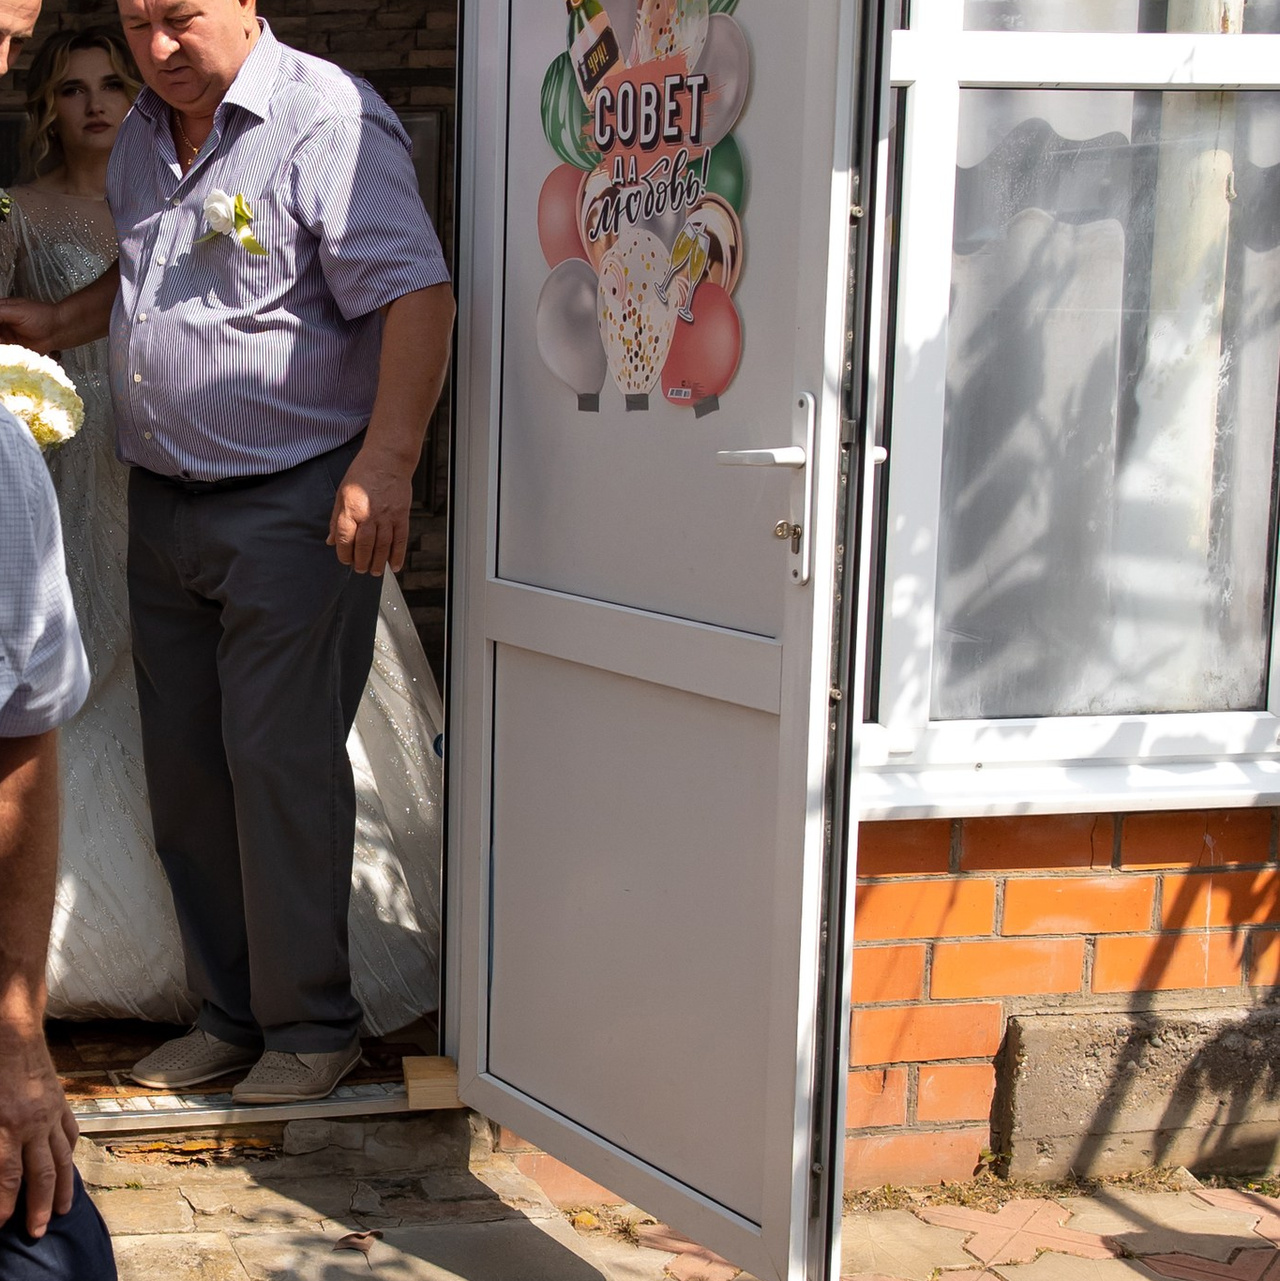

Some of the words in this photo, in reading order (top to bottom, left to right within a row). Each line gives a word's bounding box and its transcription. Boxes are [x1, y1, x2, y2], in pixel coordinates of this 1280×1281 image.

[587, 42, 609, 77] УРА!
[593, 74, 709, 153] СОВЕТ
[589, 148, 711, 240] любовь!
[611, 155, 638, 187] ДА
